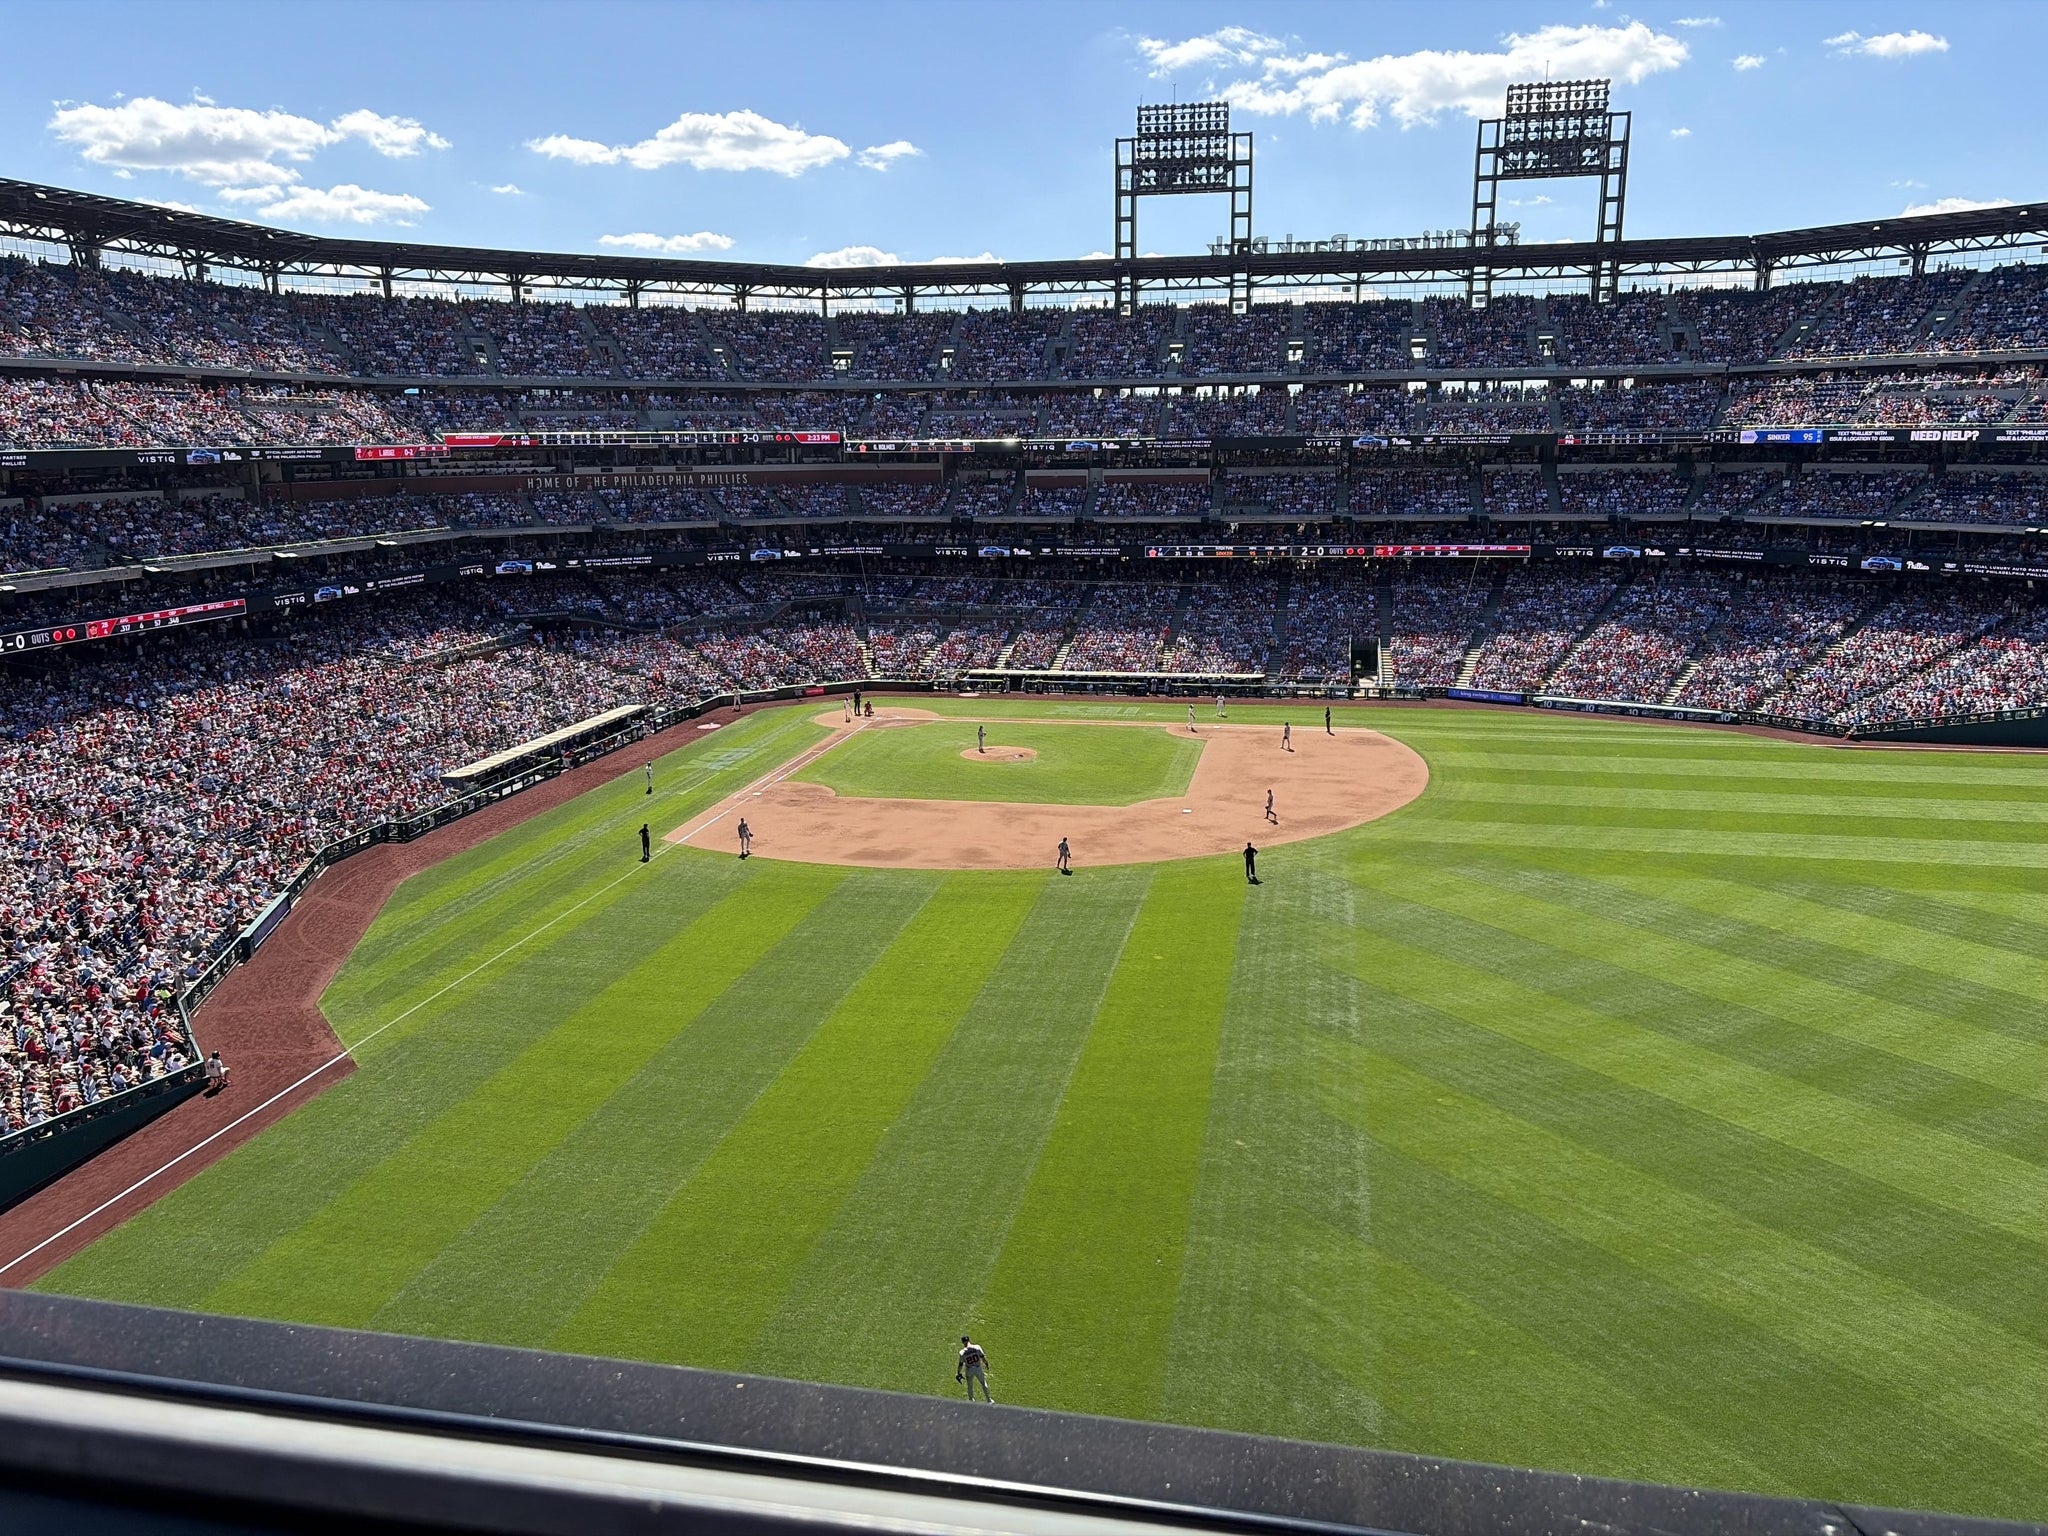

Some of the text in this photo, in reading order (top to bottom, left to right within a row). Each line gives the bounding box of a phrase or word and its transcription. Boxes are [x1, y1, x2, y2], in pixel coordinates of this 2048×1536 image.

[1803, 433, 1813, 441] 95
[1910, 430, 1980, 441] NEED HELP?
[566, 477, 580, 488] OF
[586, 476, 607, 487] HE
[614, 475, 694, 486] PHILADELPHIA
[701, 474, 748, 485] PHILLIES
[1809, 558, 1848, 566] VISTIQ
[1906, 561, 1929, 570] Phillies
[460, 568, 483, 576] VISTIQ
[274, 596, 305, 606] VISTIQ
[31, 633, 49, 644] OUTS
[1544, 700, 1552, 708] 10
[1674, 712, 1683, 720] 10
[965, 1354, 979, 1365] 20
